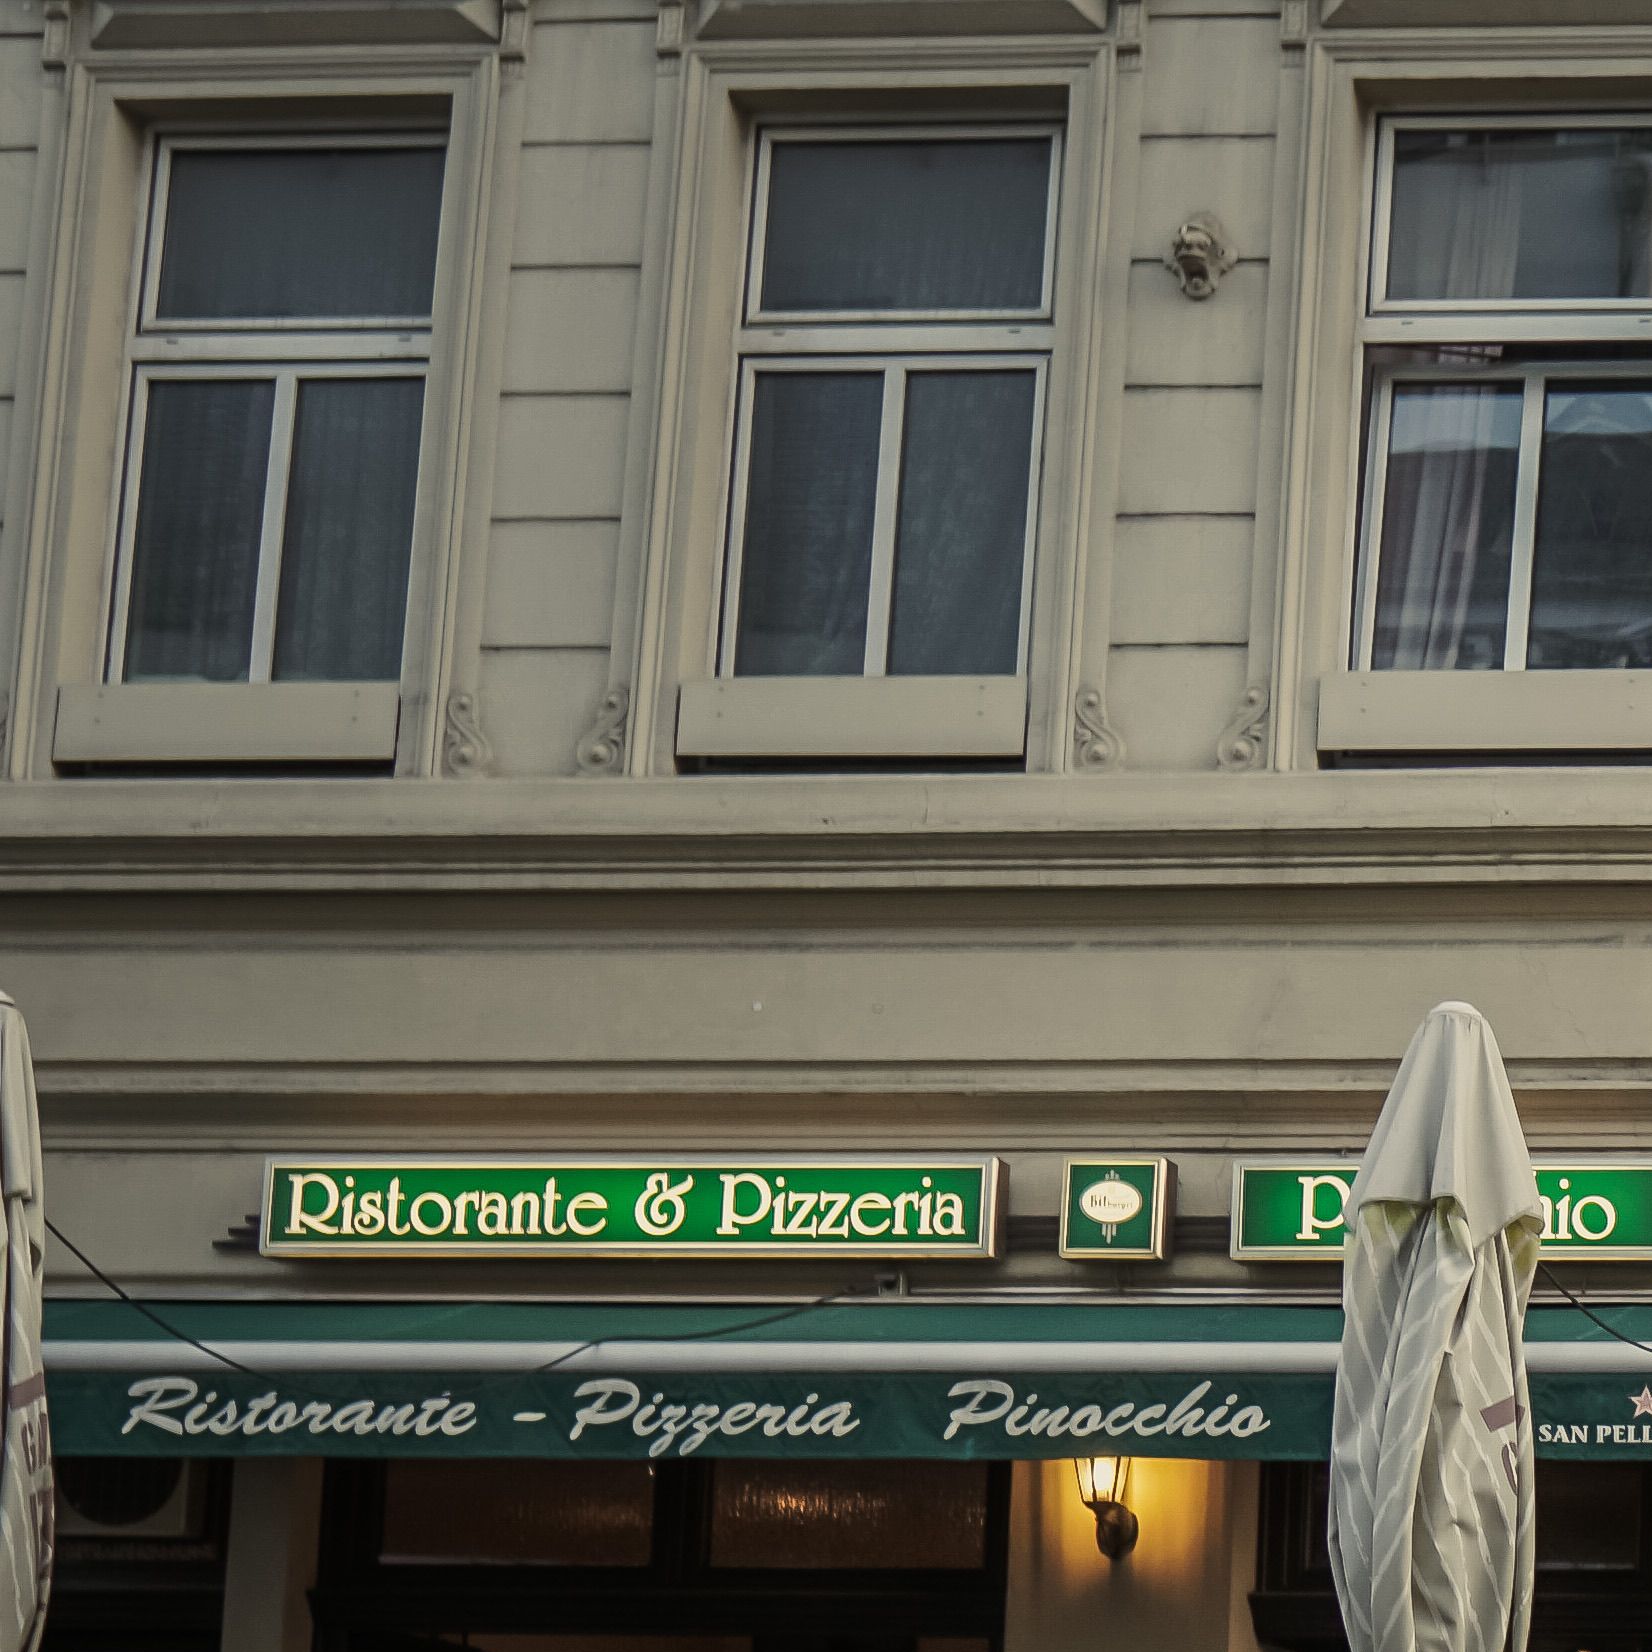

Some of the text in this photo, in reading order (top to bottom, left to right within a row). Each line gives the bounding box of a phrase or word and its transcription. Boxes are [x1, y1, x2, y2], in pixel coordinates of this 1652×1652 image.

[284, 1171, 967, 1239] Ristorante & Pizzeria
[121, 1375, 477, 1436] Ristorante
[569, 1378, 861, 1458] Pizzeria
[942, 1379, 1271, 1441] Pinocchio
[1538, 1423, 1589, 1445] SAN
